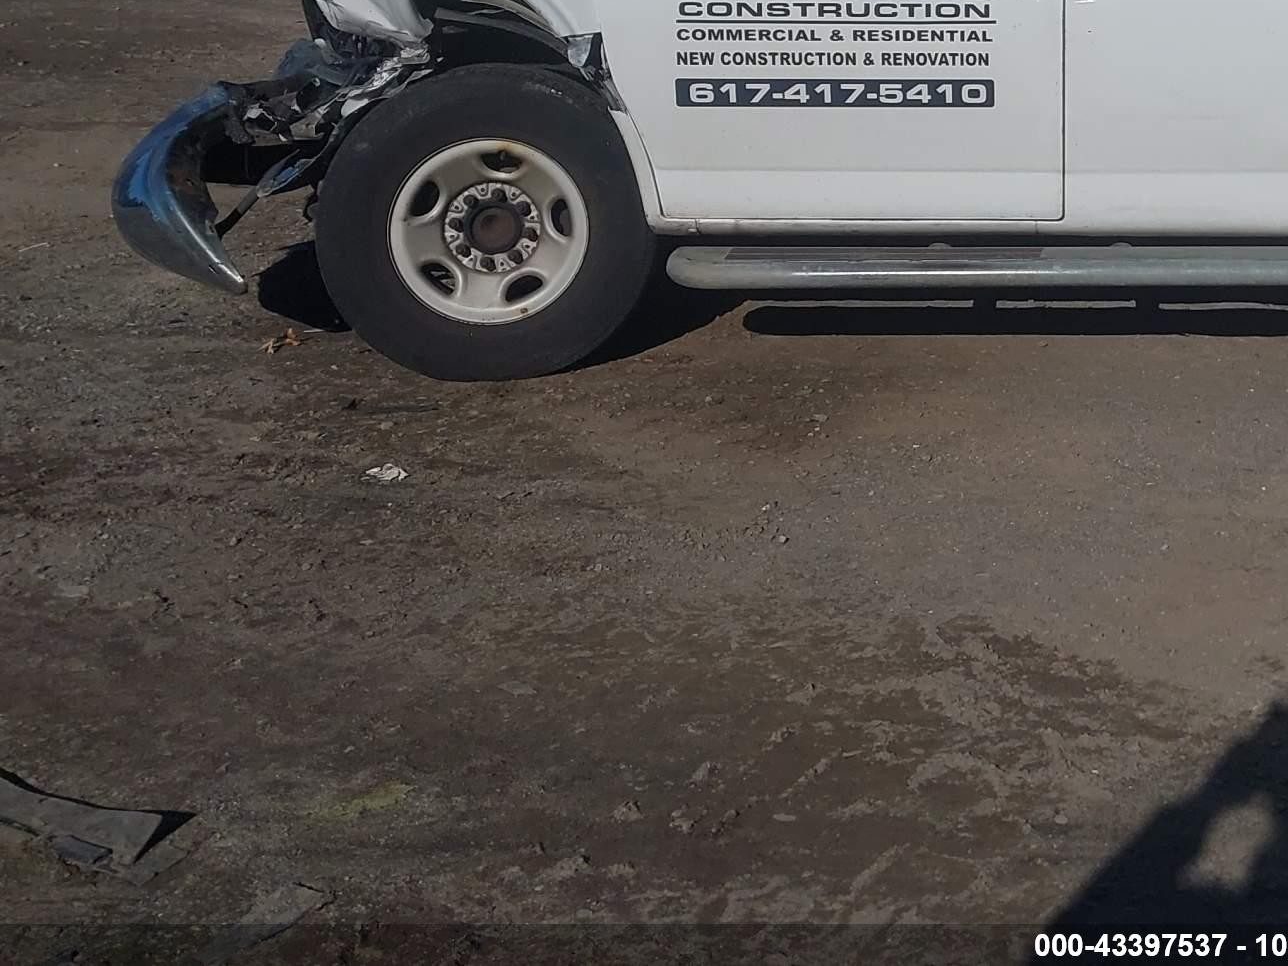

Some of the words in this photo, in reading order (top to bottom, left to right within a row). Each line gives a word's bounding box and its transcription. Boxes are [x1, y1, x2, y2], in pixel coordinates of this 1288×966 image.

[678, 1, 990, 19] CONSTRUCTION
[676, 28, 822, 42] COMMERCIAL
[829, 29, 845, 42] &
[852, 29, 993, 43] RESIDENTIAL
[676, 51, 715, 66] NEW
[720, 51, 857, 66] CONSTRUCTION
[862, 52, 875, 66] &
[881, 52, 990, 67] RENOVATION
[689, 82, 987, 104] 617-417-5410
